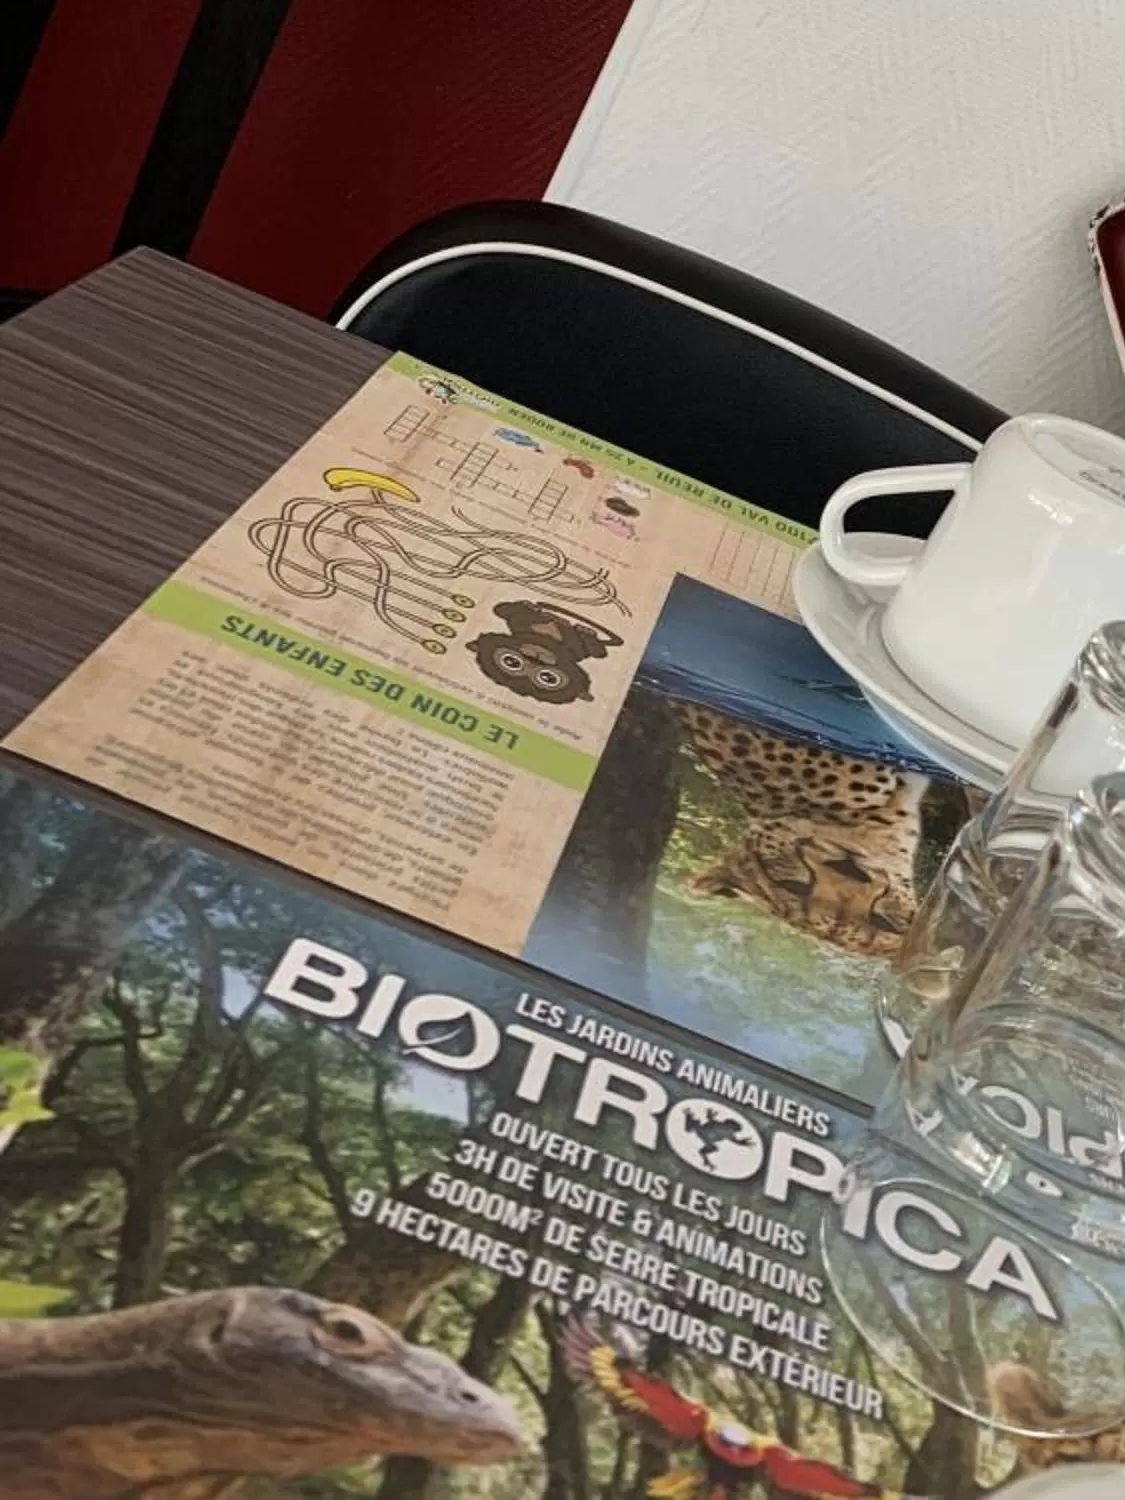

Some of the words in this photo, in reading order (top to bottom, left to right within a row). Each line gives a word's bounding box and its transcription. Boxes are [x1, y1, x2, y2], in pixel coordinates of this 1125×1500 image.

[218, 611, 348, 679] ENFANTS
[347, 664, 405, 704] DES
[406, 689, 480, 735] COIN
[483, 720, 520, 751] LE
[264, 937, 1060, 1320] BIOTROPICA
[516, 993, 566, 1027] LES
[567, 1014, 673, 1071] JARDINS
[677, 1058, 830, 1135] ANIMALIERS
[455, 1140, 497, 1173] 3H
[499, 1156, 538, 1190] DE
[544, 1172, 628, 1226] VISITE
[633, 1209, 651, 1235] &
[656, 1220, 822, 1303] ANIMATIONS
[492, 1113, 598, 1170] OUVERT
[604, 1154, 669, 1200] TOUS
[673, 1183, 722, 1221] LES
[725, 1206, 806, 1255] JOURS
[352, 1188, 375, 1216] 9
[377, 1198, 528, 1276] HECTARES
[530, 1258, 572, 1295] DE
[574, 1275, 725, 1354] PARCOURS
[544, 1217, 584, 1252] DE
[588, 1233, 679, 1290] SERRE
[685, 1270, 832, 1351] TROPICALE
